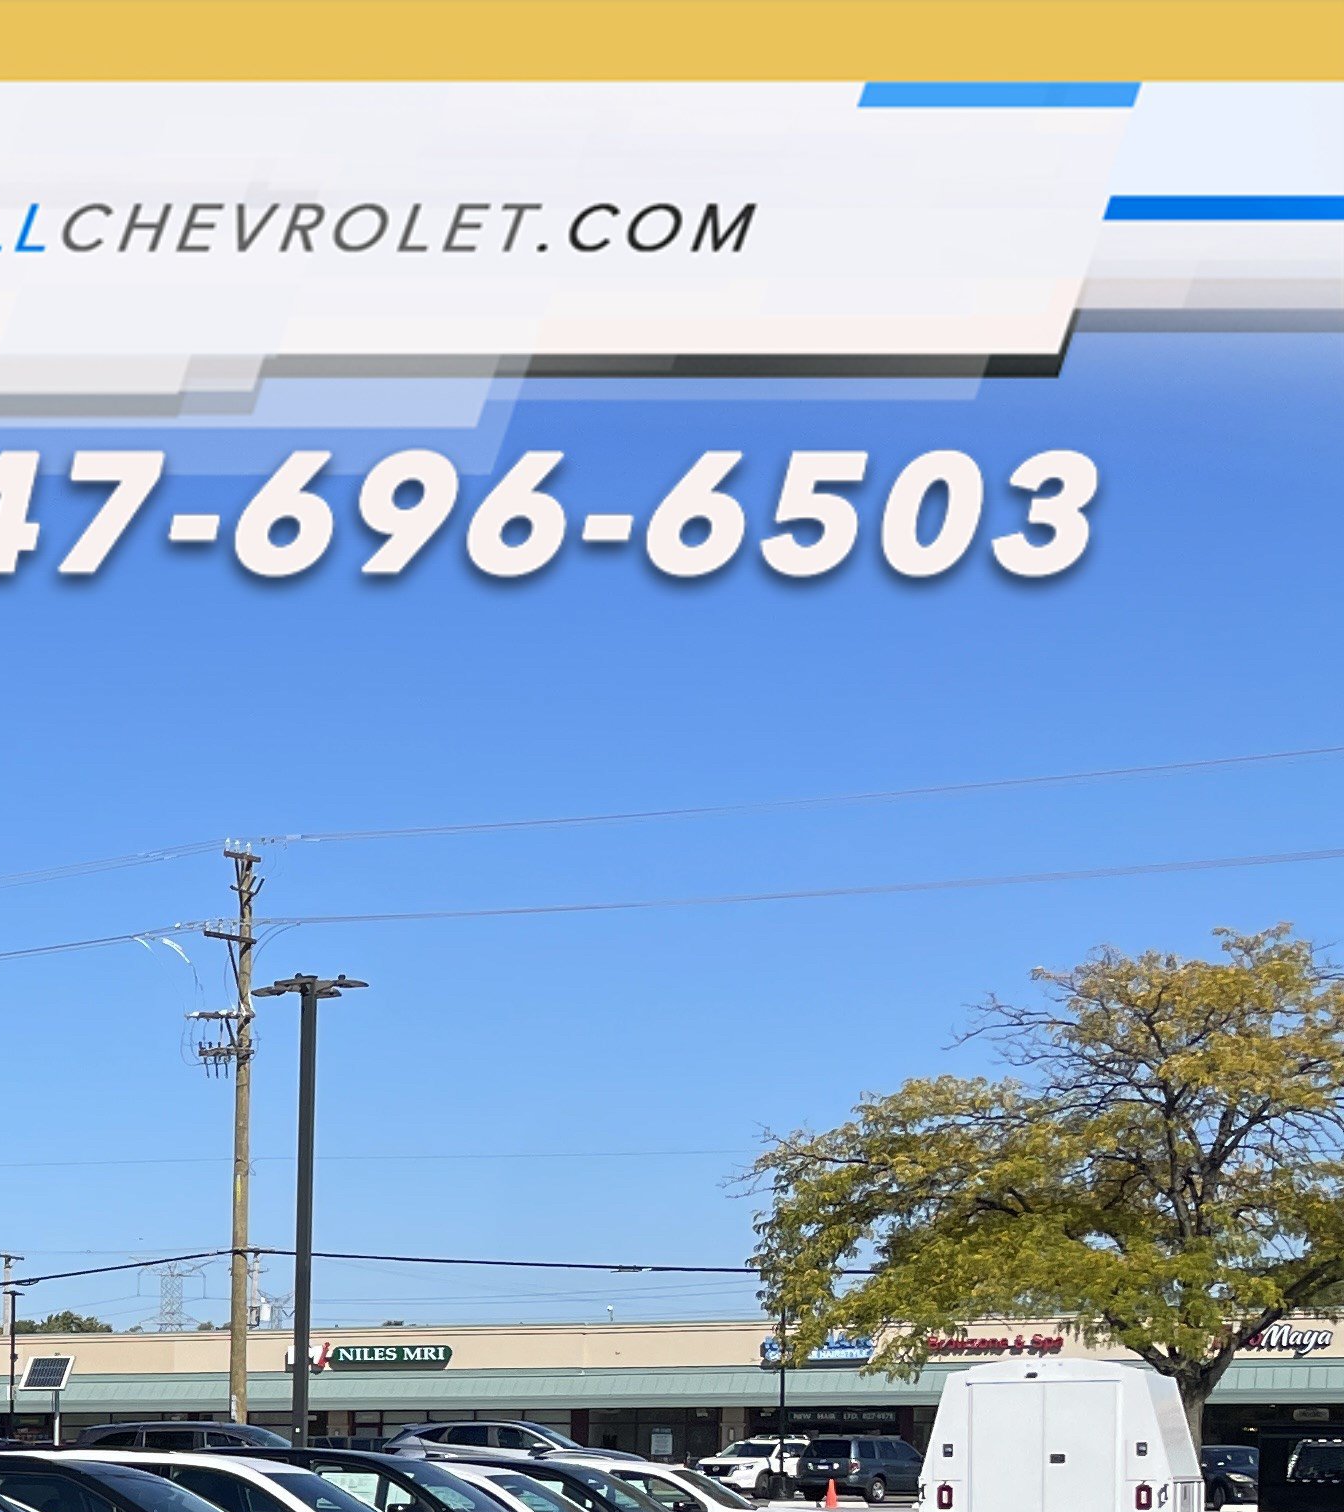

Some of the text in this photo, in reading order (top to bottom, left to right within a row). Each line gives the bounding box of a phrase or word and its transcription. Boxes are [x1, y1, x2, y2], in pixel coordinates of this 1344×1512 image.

[1014, 1334, 1025, 1349] &
[1031, 1333, 1064, 1353] Spa
[1261, 1323, 1333, 1354] Maya
[338, 1347, 398, 1361] NILES
[402, 1346, 446, 1361] MRI
